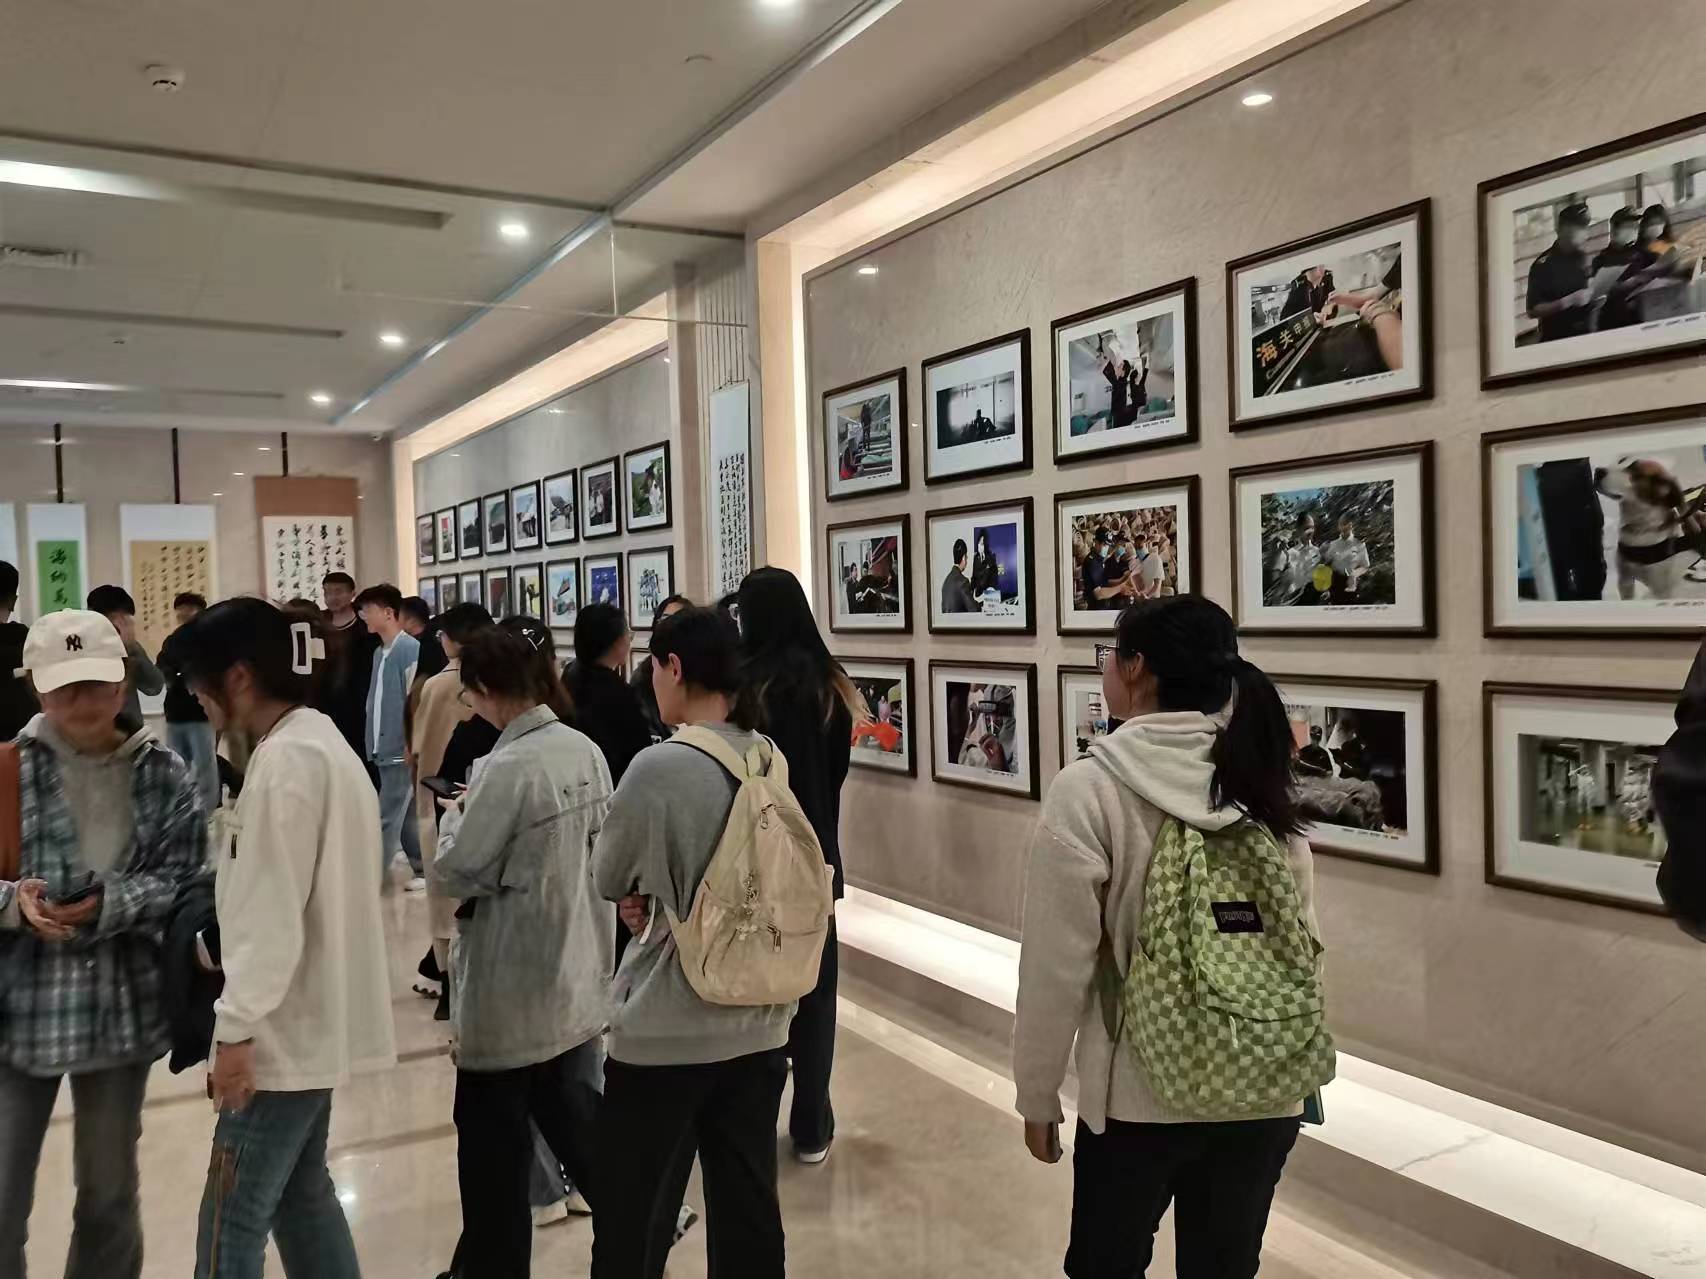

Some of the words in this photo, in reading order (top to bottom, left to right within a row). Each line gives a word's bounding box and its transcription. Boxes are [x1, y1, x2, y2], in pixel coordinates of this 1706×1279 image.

[48, 548, 68, 611] 海纳百
[65, 634, 83, 651] NY
